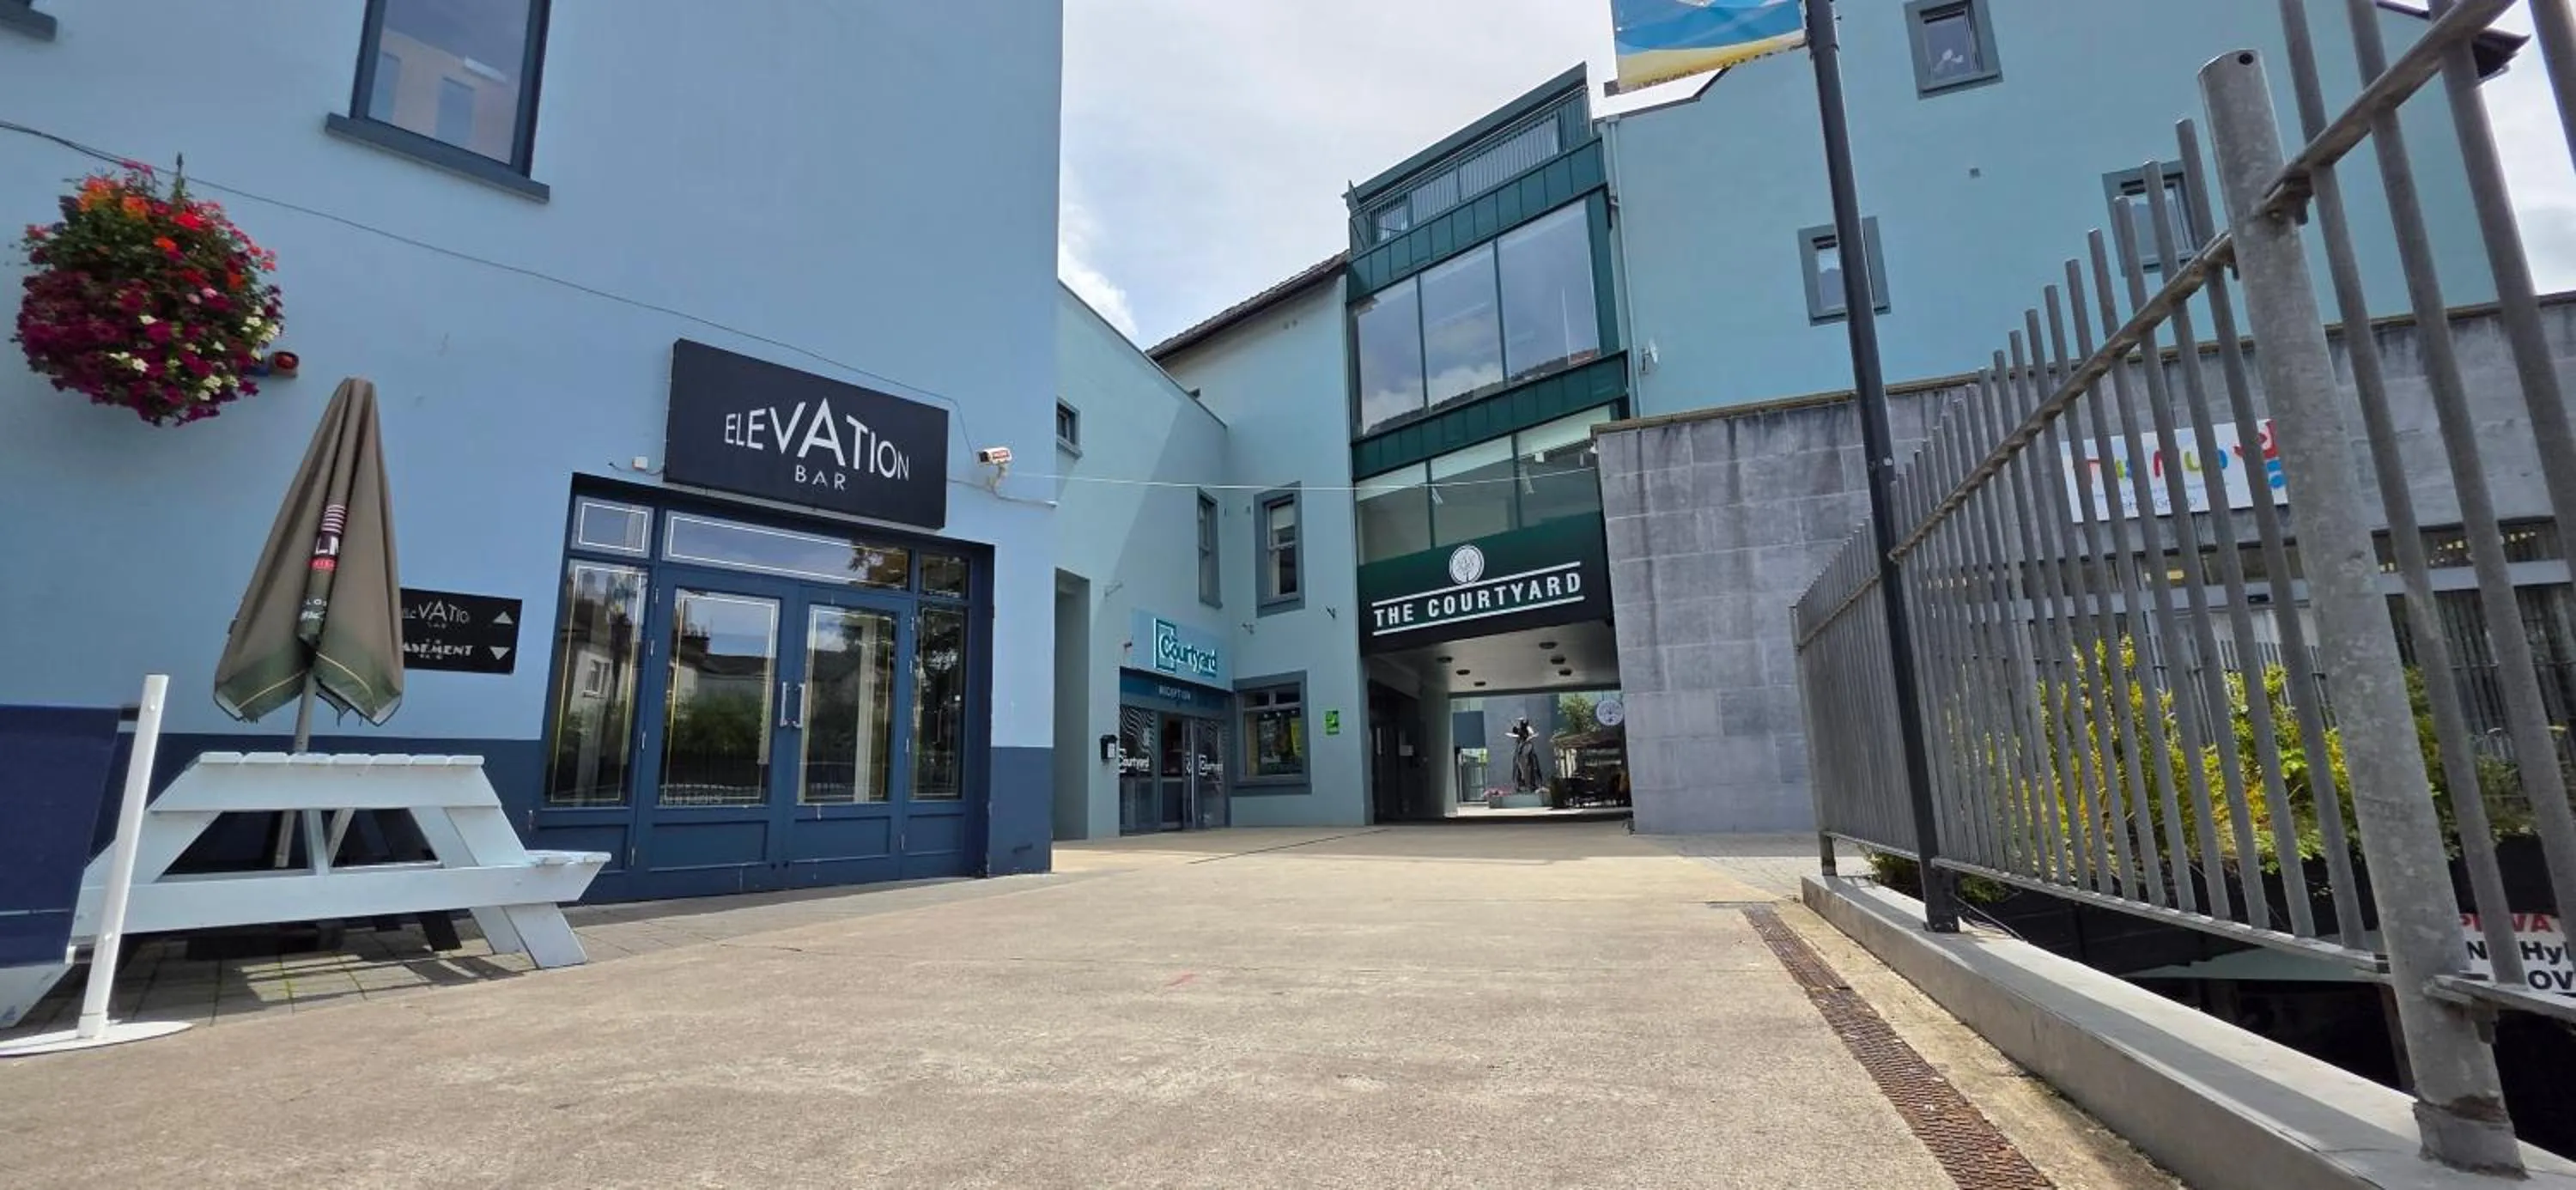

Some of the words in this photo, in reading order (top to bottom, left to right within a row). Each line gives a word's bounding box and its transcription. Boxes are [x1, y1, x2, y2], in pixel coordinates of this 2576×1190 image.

[724, 397, 910, 481] ELEVATION
[794, 464, 846, 490] BAR
[1374, 604, 1415, 628] THE
[1427, 572, 1582, 617] COURTYARD
[403, 641, 473, 656] ASEMENT
[1158, 633, 1218, 674] Courtyard
